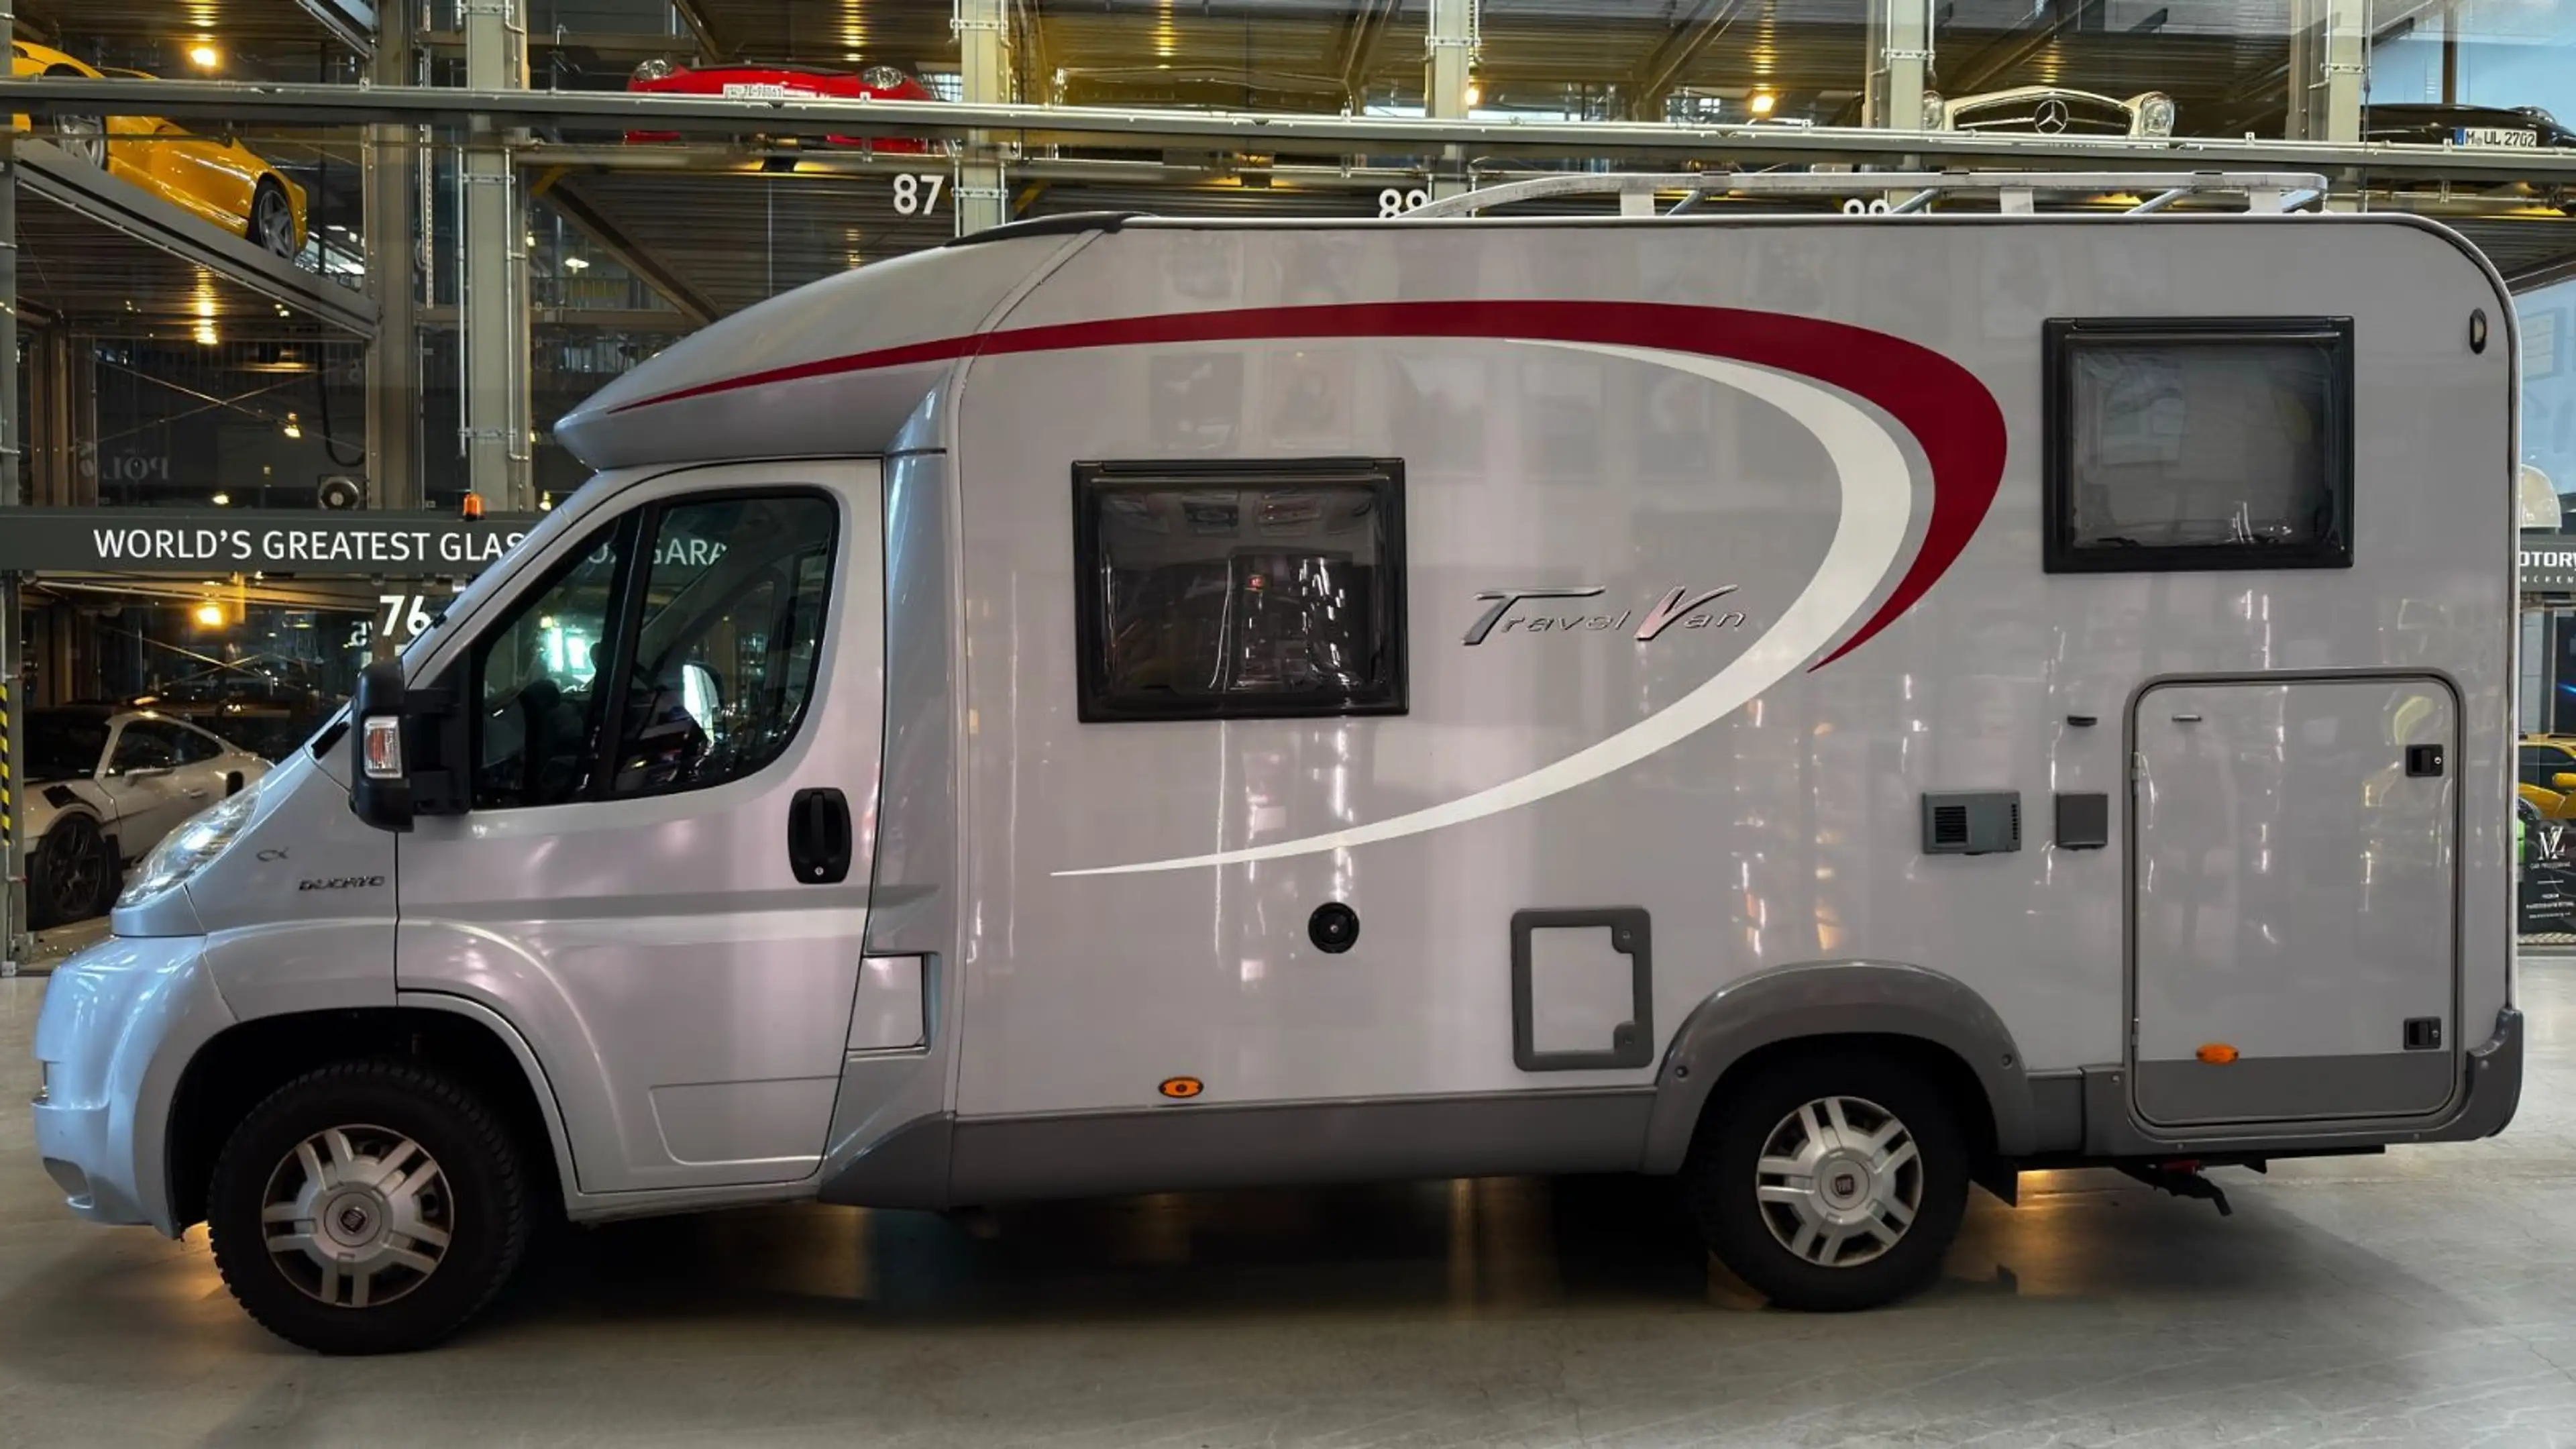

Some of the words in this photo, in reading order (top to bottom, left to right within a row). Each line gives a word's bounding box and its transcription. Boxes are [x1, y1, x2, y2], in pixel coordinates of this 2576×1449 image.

[2484, 131, 2501, 145] UL
[894, 174, 945, 215] 87
[93, 529, 252, 559] WORLD’S
[262, 531, 431, 561] GREATEST
[2520, 551, 2576, 568] OTOR
[380, 595, 432, 637] 76
[1463, 586, 1630, 645] Travel
[1634, 586, 1746, 641] Van
